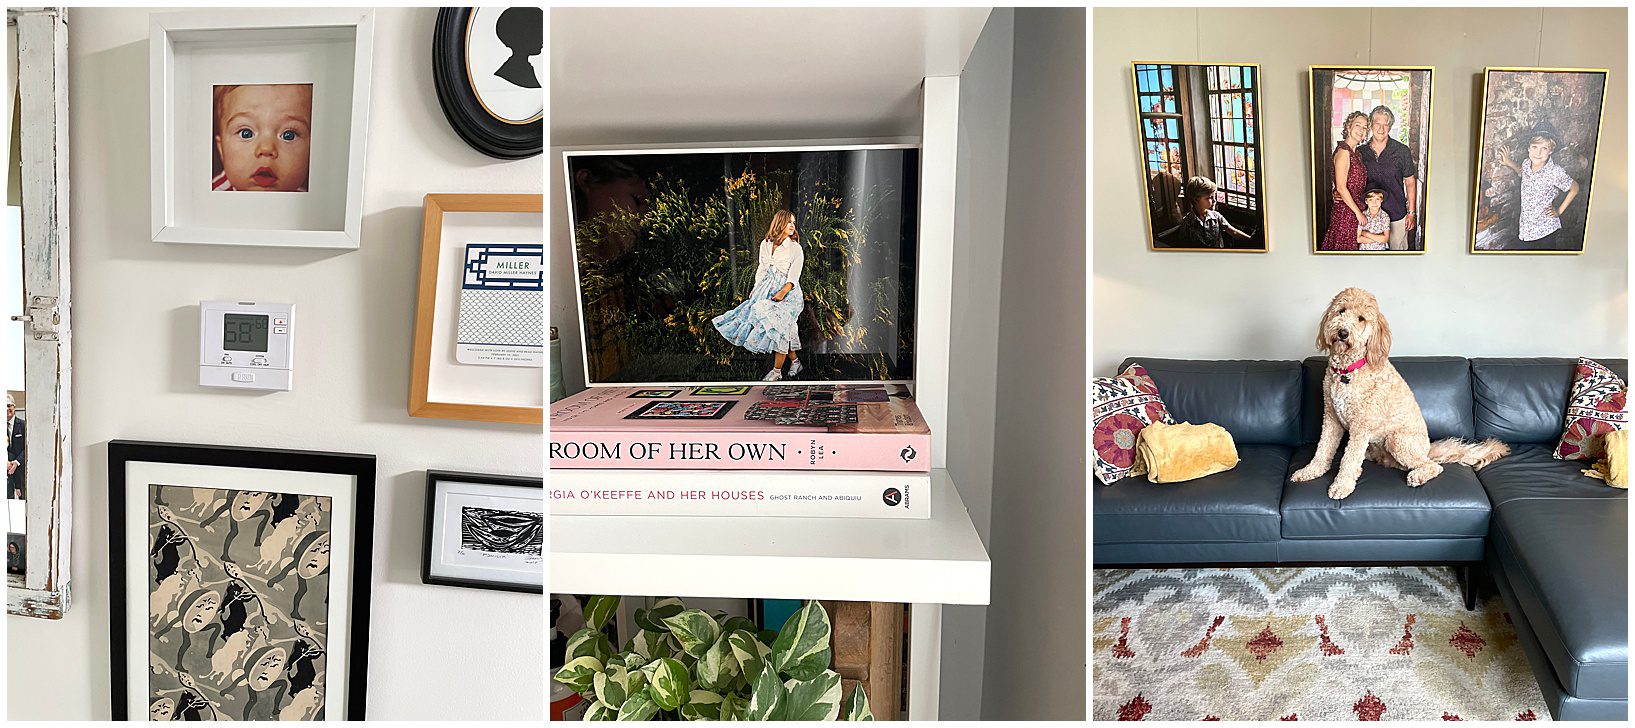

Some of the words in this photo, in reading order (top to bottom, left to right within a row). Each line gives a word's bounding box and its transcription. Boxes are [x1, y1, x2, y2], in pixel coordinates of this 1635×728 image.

[496, 261, 530, 270] MILLER
[549, 442, 622, 460] ROOM
[629, 442, 663, 460] OF
[669, 442, 721, 460] HER
[728, 443, 787, 461] OWN
[580, 490, 642, 500] O'KEEFFE
[647, 490, 675, 500] AND
[680, 490, 706, 500] HER
[711, 490, 765, 501] HOUSES
